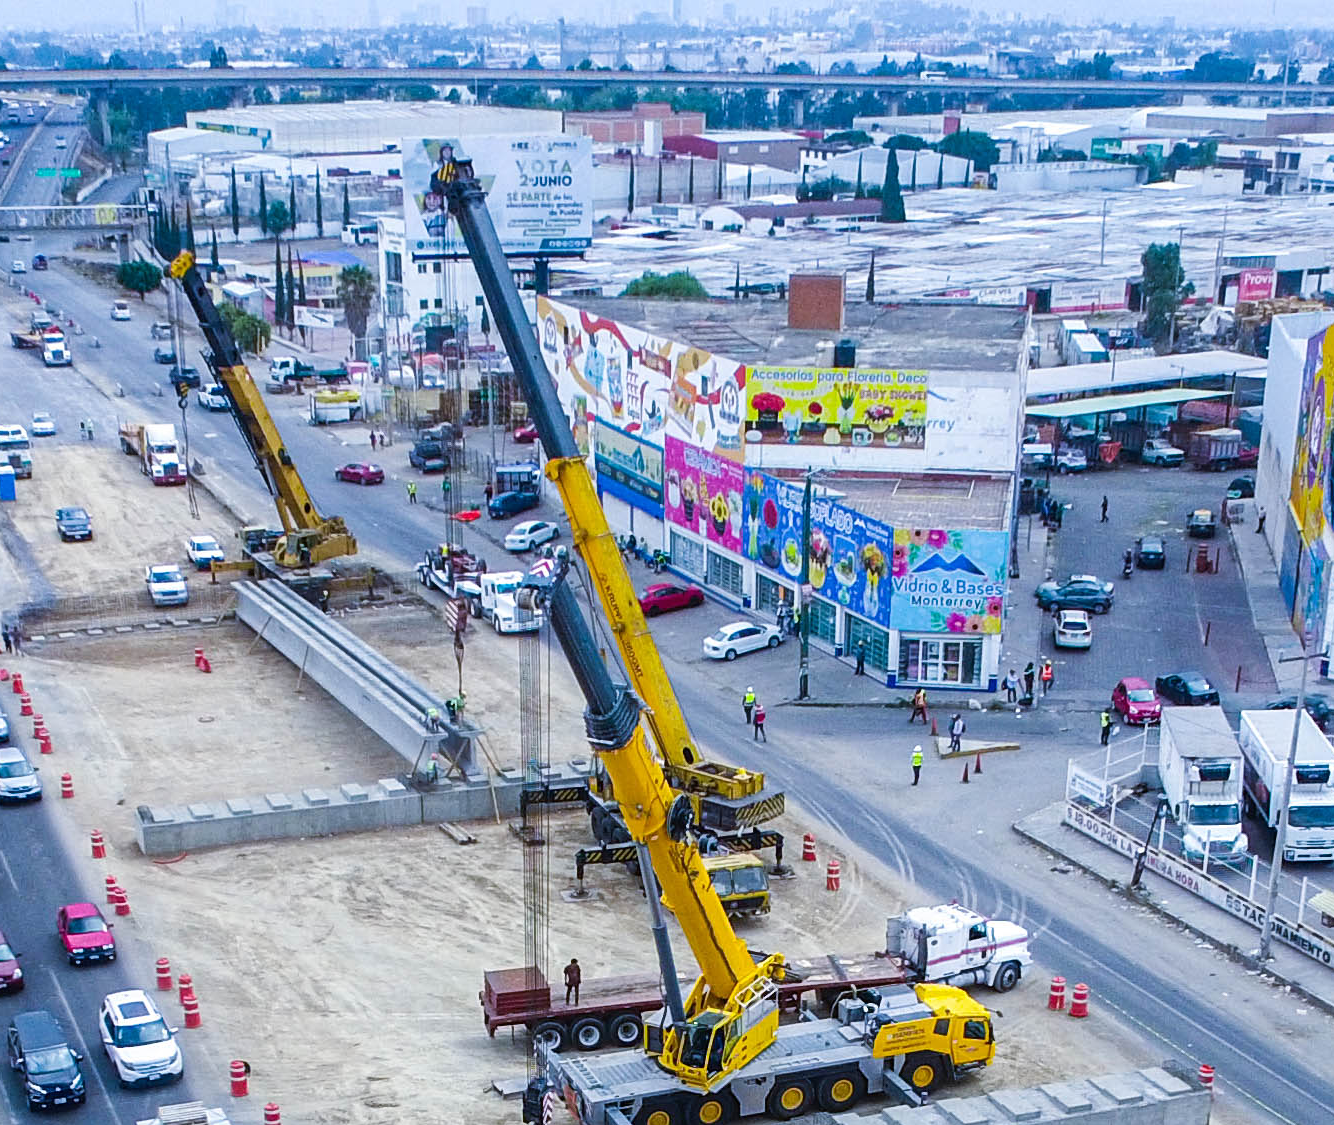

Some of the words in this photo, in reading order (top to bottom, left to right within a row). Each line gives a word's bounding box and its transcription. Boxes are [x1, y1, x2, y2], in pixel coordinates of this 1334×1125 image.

[515, 160, 572, 173] VOTA
[532, 175, 573, 187] JUNIO
[751, 369, 814, 381] Accesorios
[817, 371, 844, 384] para
[892, 576, 938, 594] Vidrio
[940, 578, 953, 594] &
[956, 579, 1005, 597] Bases
[911, 594, 982, 610] Monterrey
[1120, 840, 1134, 853] LA
[1175, 871, 1200, 891] HORA
[1225, 894, 1331, 964] ESTACONAMIENTO
